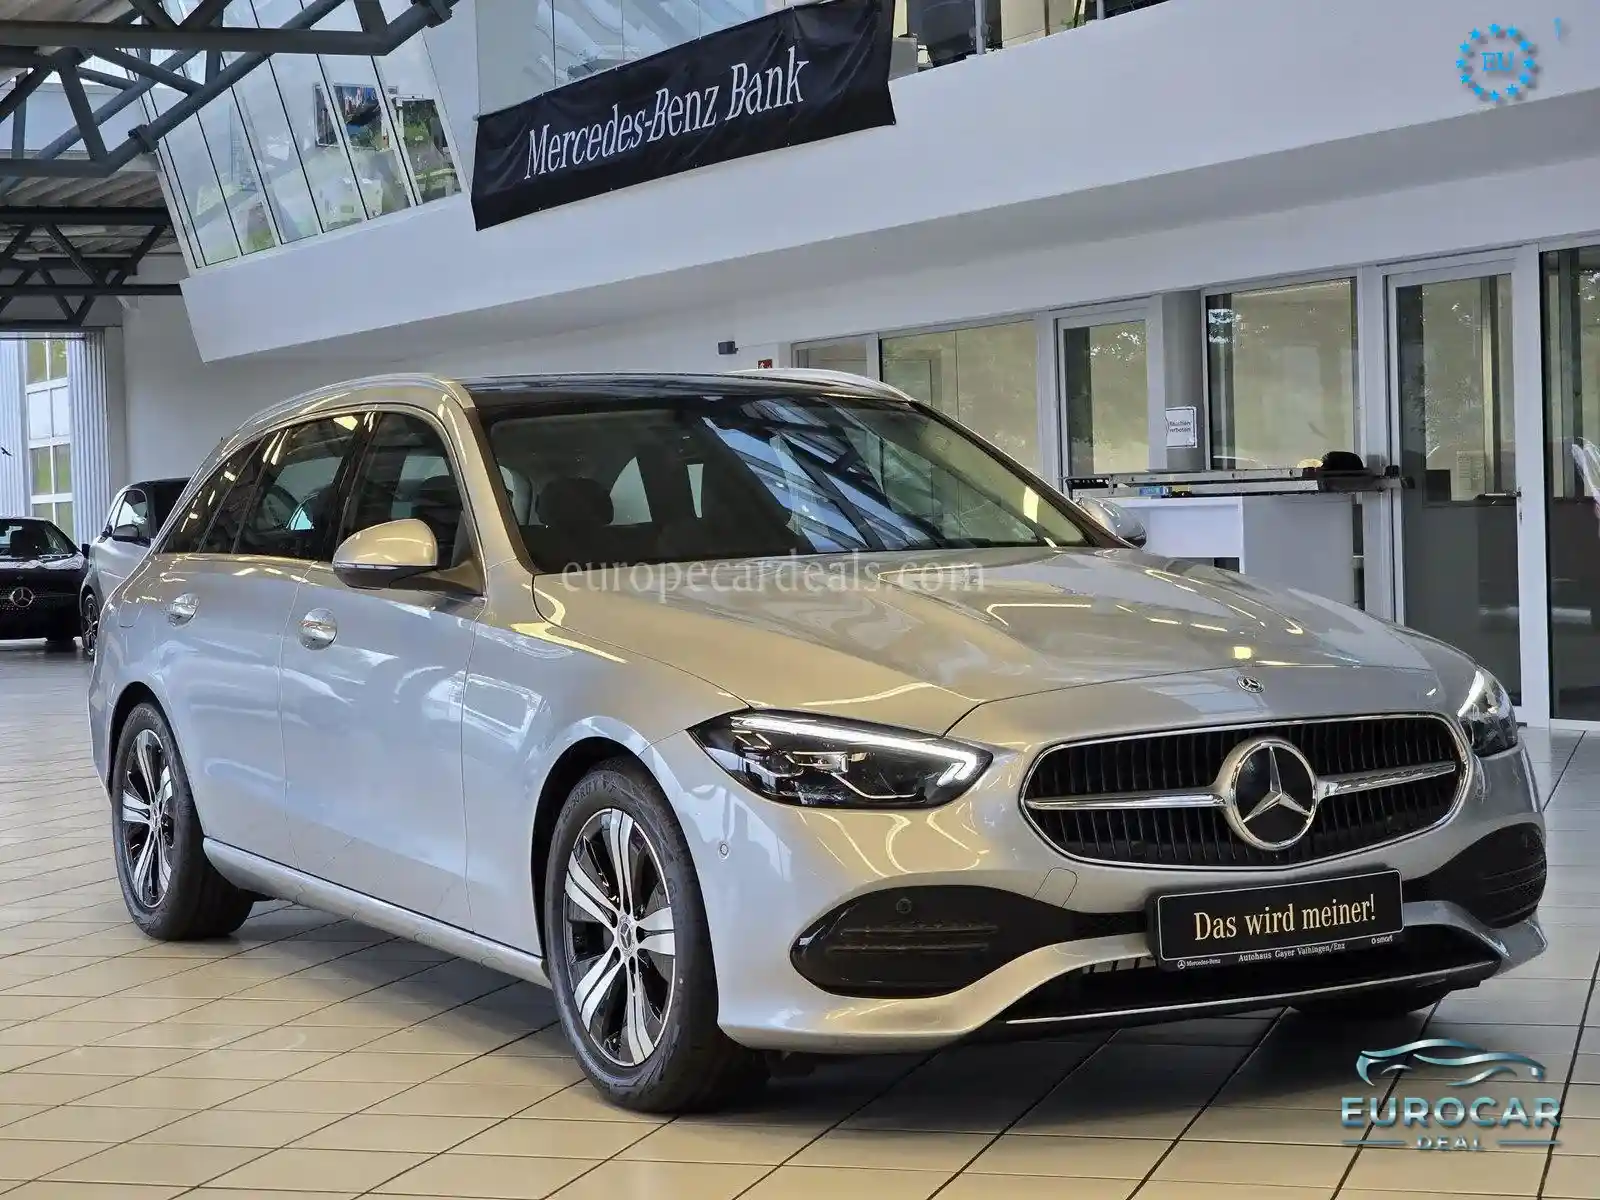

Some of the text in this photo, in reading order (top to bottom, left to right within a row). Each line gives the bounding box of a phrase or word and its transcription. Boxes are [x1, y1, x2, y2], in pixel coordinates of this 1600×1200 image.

[524, 45, 810, 180] Mercedes-Benz Bank
[1193, 893, 1376, 941] Das wird meiner!
[1238, 942, 1346, 962] Autohaus Gayer Vaihingen/Enz
